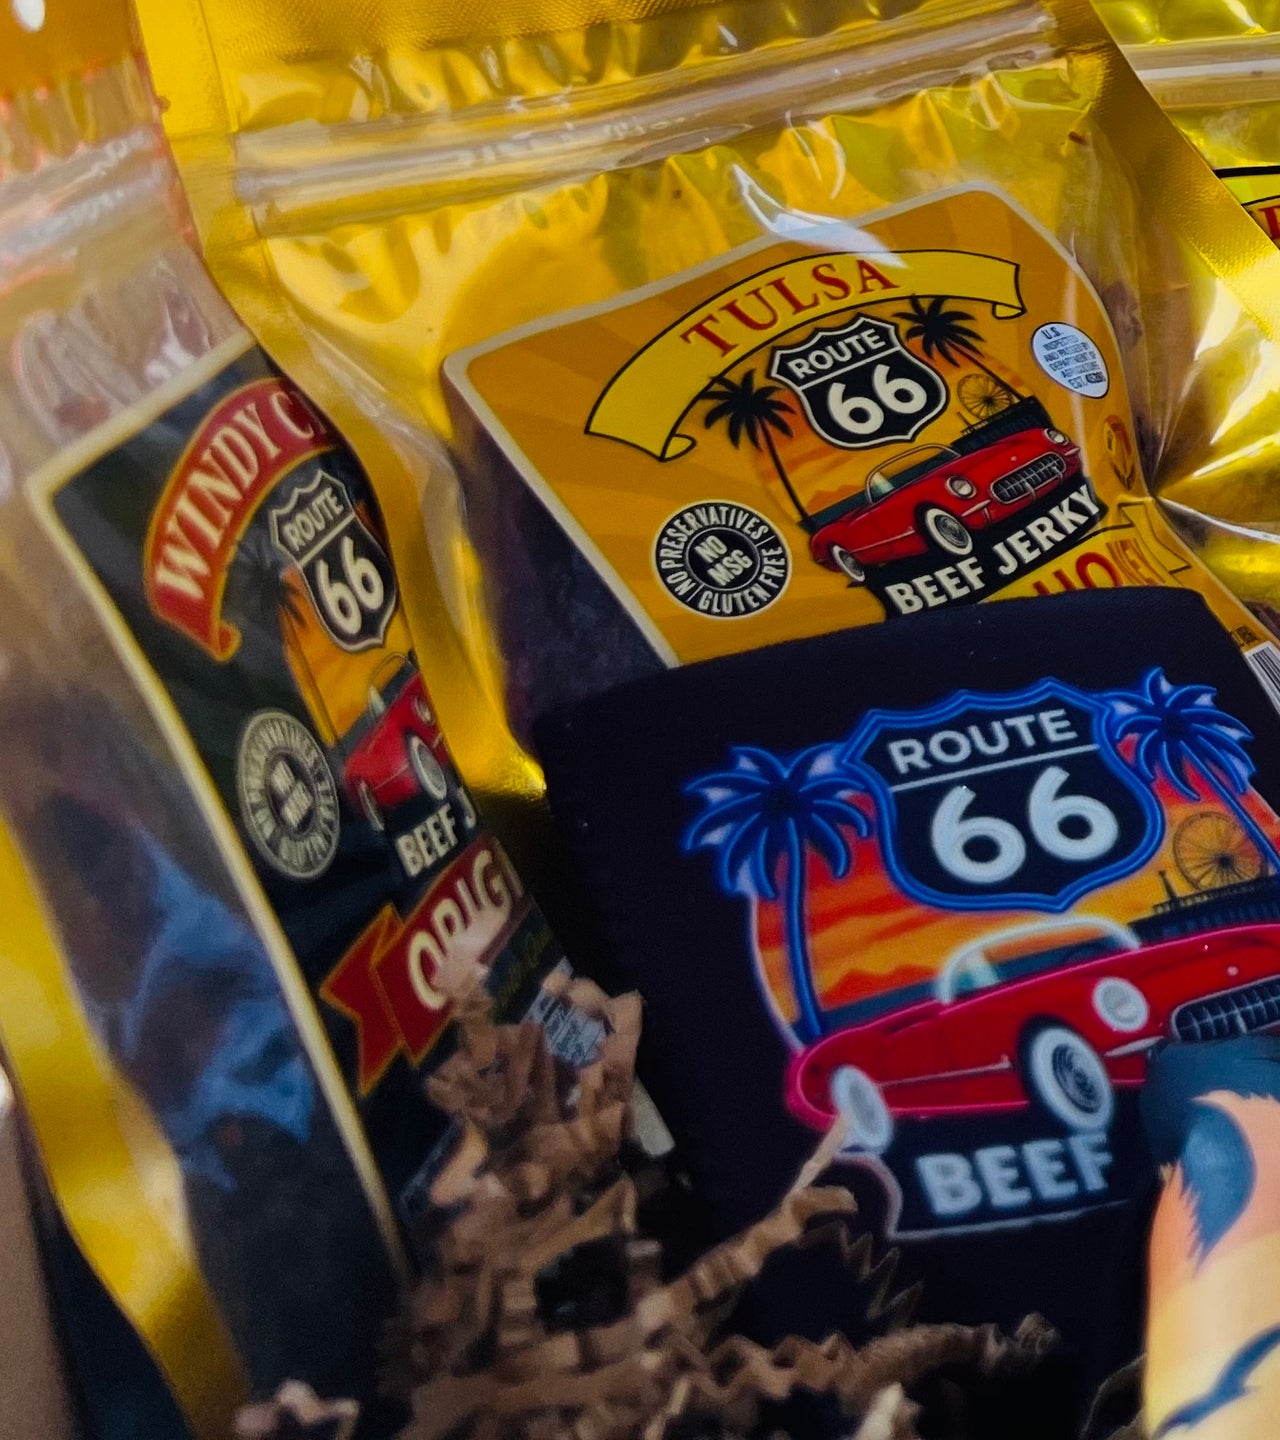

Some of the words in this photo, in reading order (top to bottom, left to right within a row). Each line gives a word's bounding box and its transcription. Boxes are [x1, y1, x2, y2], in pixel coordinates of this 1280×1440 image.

[681, 259, 899, 360] TULSA
[788, 327, 886, 380] ROUTE
[828, 363, 927, 435] 66
[156, 402, 281, 599] WINDY
[283, 487, 344, 552] ROUTE
[660, 505, 769, 570] PRESERVATIVES
[694, 535, 728, 563] NO
[707, 549, 753, 586] MSG
[884, 557, 986, 615] BEEF
[992, 484, 1100, 576] JERKY
[316, 536, 384, 635] 66
[666, 570, 696, 596] NO
[698, 582, 772, 614] GLUTEN
[758, 545, 786, 589] FREE
[889, 709, 1079, 774] ROUTE
[395, 803, 458, 878] BEEF
[931, 766, 1119, 885] 66
[915, 1132, 1113, 1216] BEEF
